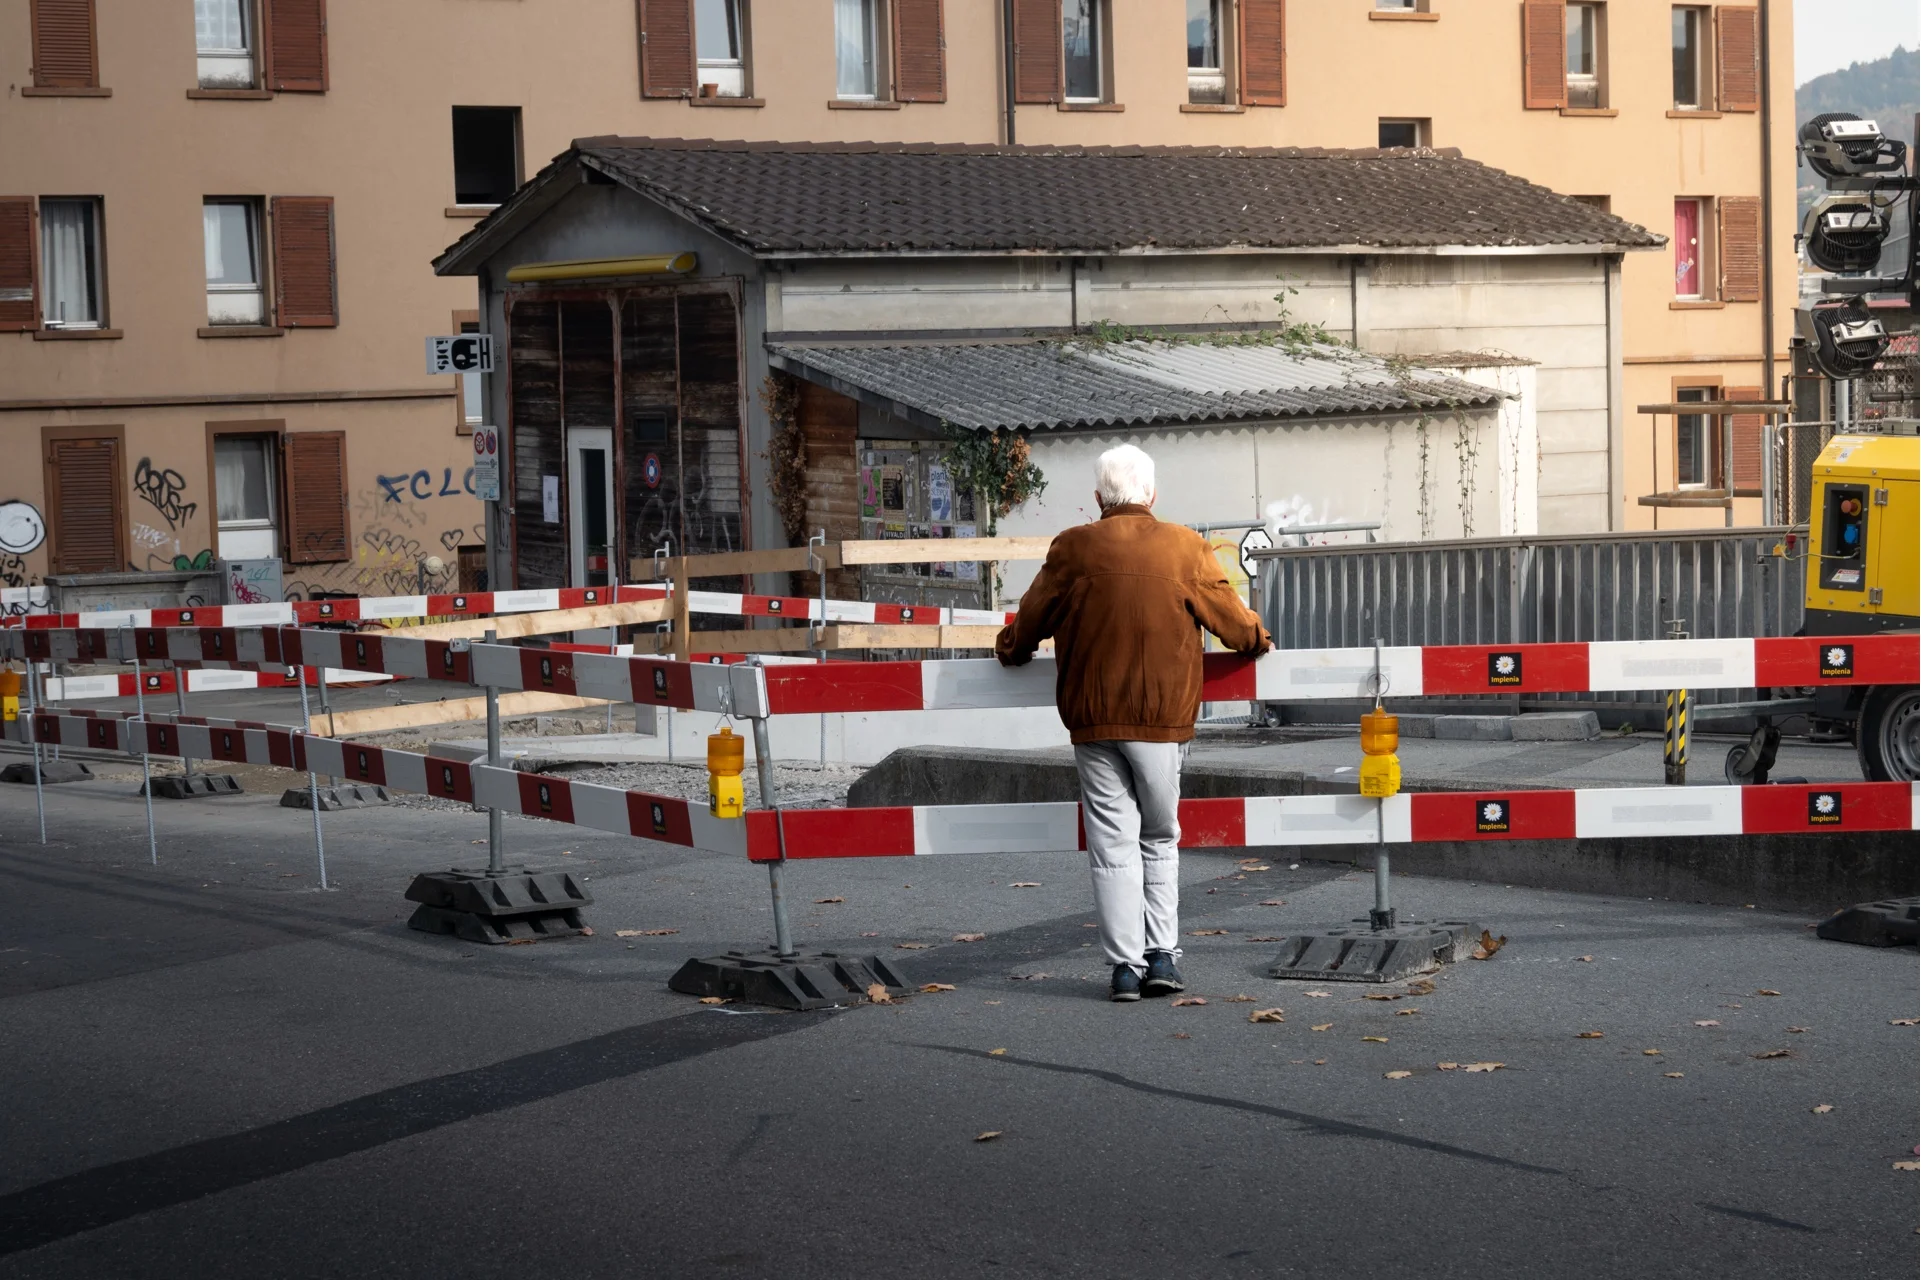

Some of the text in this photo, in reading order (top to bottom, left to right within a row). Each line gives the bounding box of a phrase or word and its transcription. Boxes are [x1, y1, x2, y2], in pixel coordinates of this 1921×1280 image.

[1822, 668, 1851, 676] Implenia
[1491, 676, 1519, 684] Implenia
[1810, 815, 1839, 823] Implenia
[1478, 823, 1507, 831] Implenia
